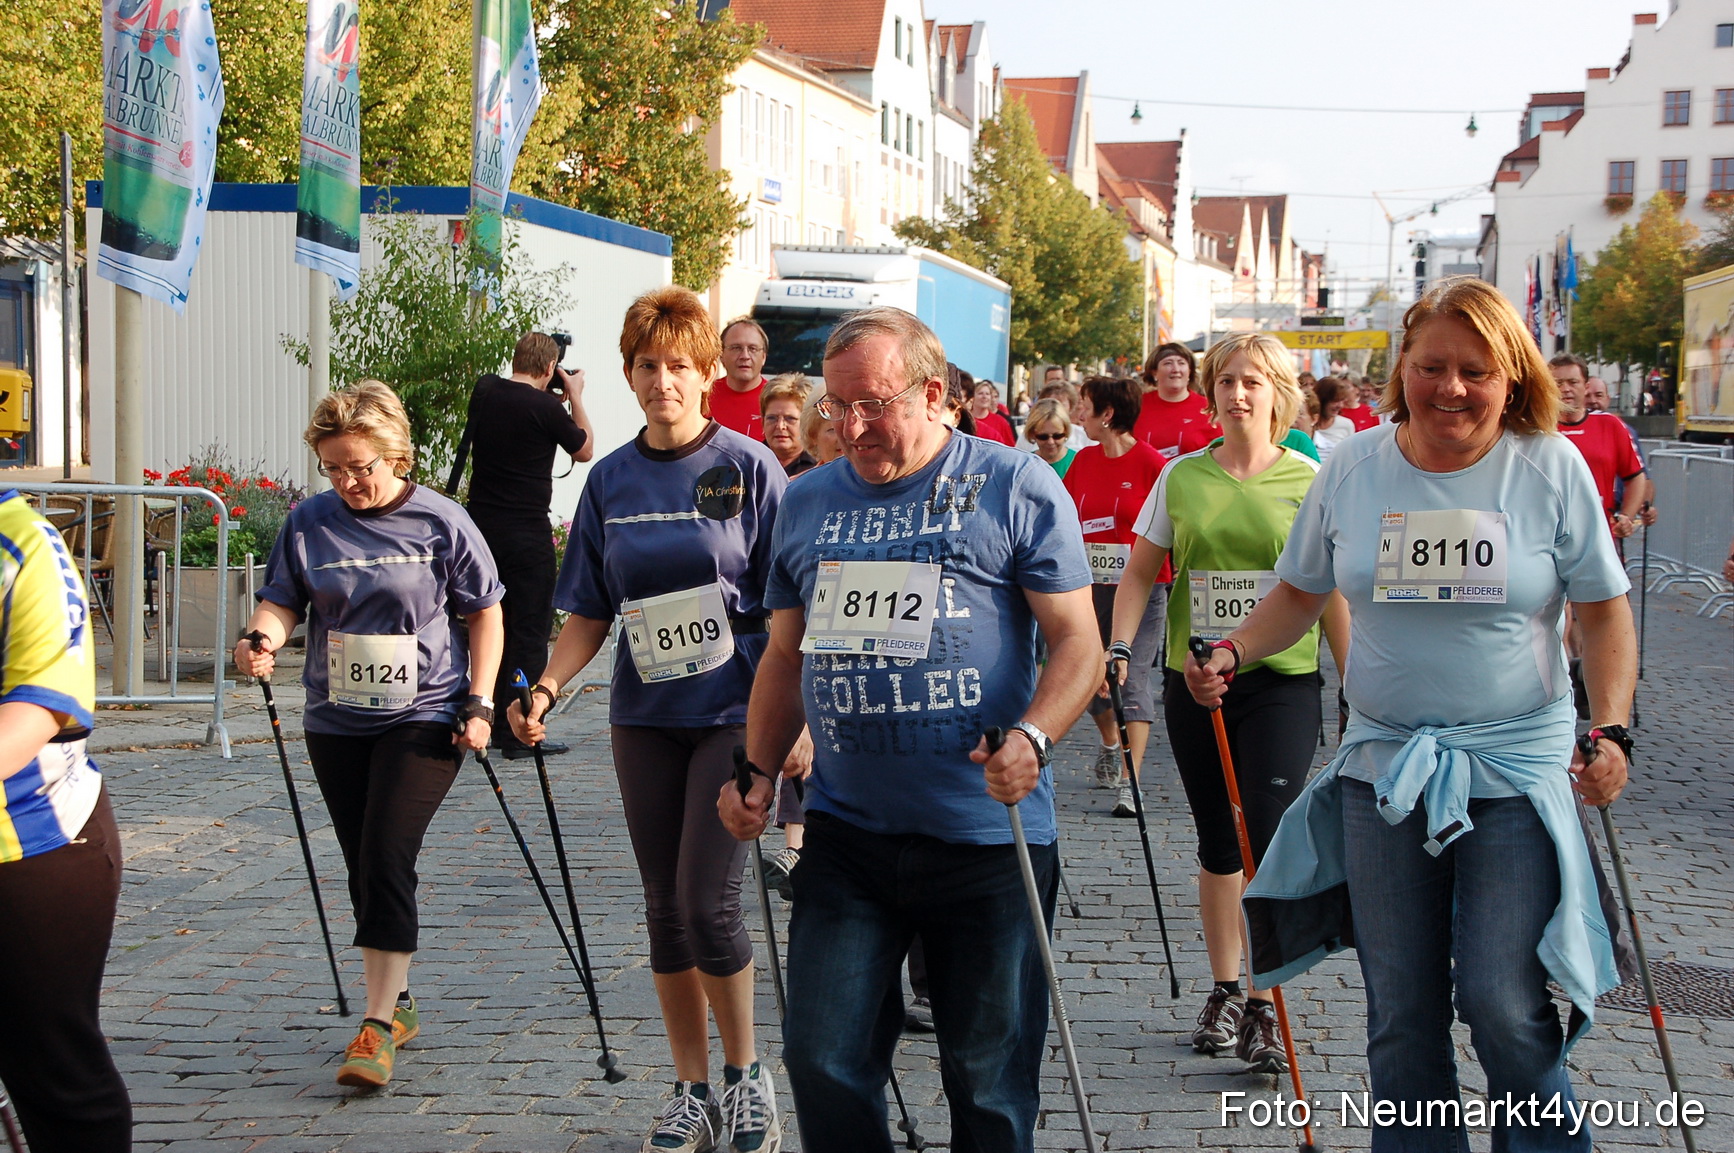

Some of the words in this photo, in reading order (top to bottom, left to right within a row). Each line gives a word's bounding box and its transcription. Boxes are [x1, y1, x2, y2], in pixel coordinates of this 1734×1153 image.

[787, 284, 855, 298] BOCK
[1299, 334, 1344, 345] START
[1382, 539, 1391, 552] N
[1411, 538, 1494, 567] 8110
[1091, 556, 1125, 569] 8029
[1212, 576, 1255, 590] Christa
[1387, 589, 1420, 597] BOCK
[1453, 587, 1503, 595] PFLEIDERER
[817, 589, 827, 602] N
[843, 590, 922, 621] 8112
[1193, 596, 1199, 607] N
[1214, 598, 1264, 618] 803
[631, 632, 640, 644] N
[657, 618, 720, 651] 8109
[877, 639, 925, 651] PFLEIDERER
[331, 658, 337, 668] N
[350, 663, 408, 684] 8124
